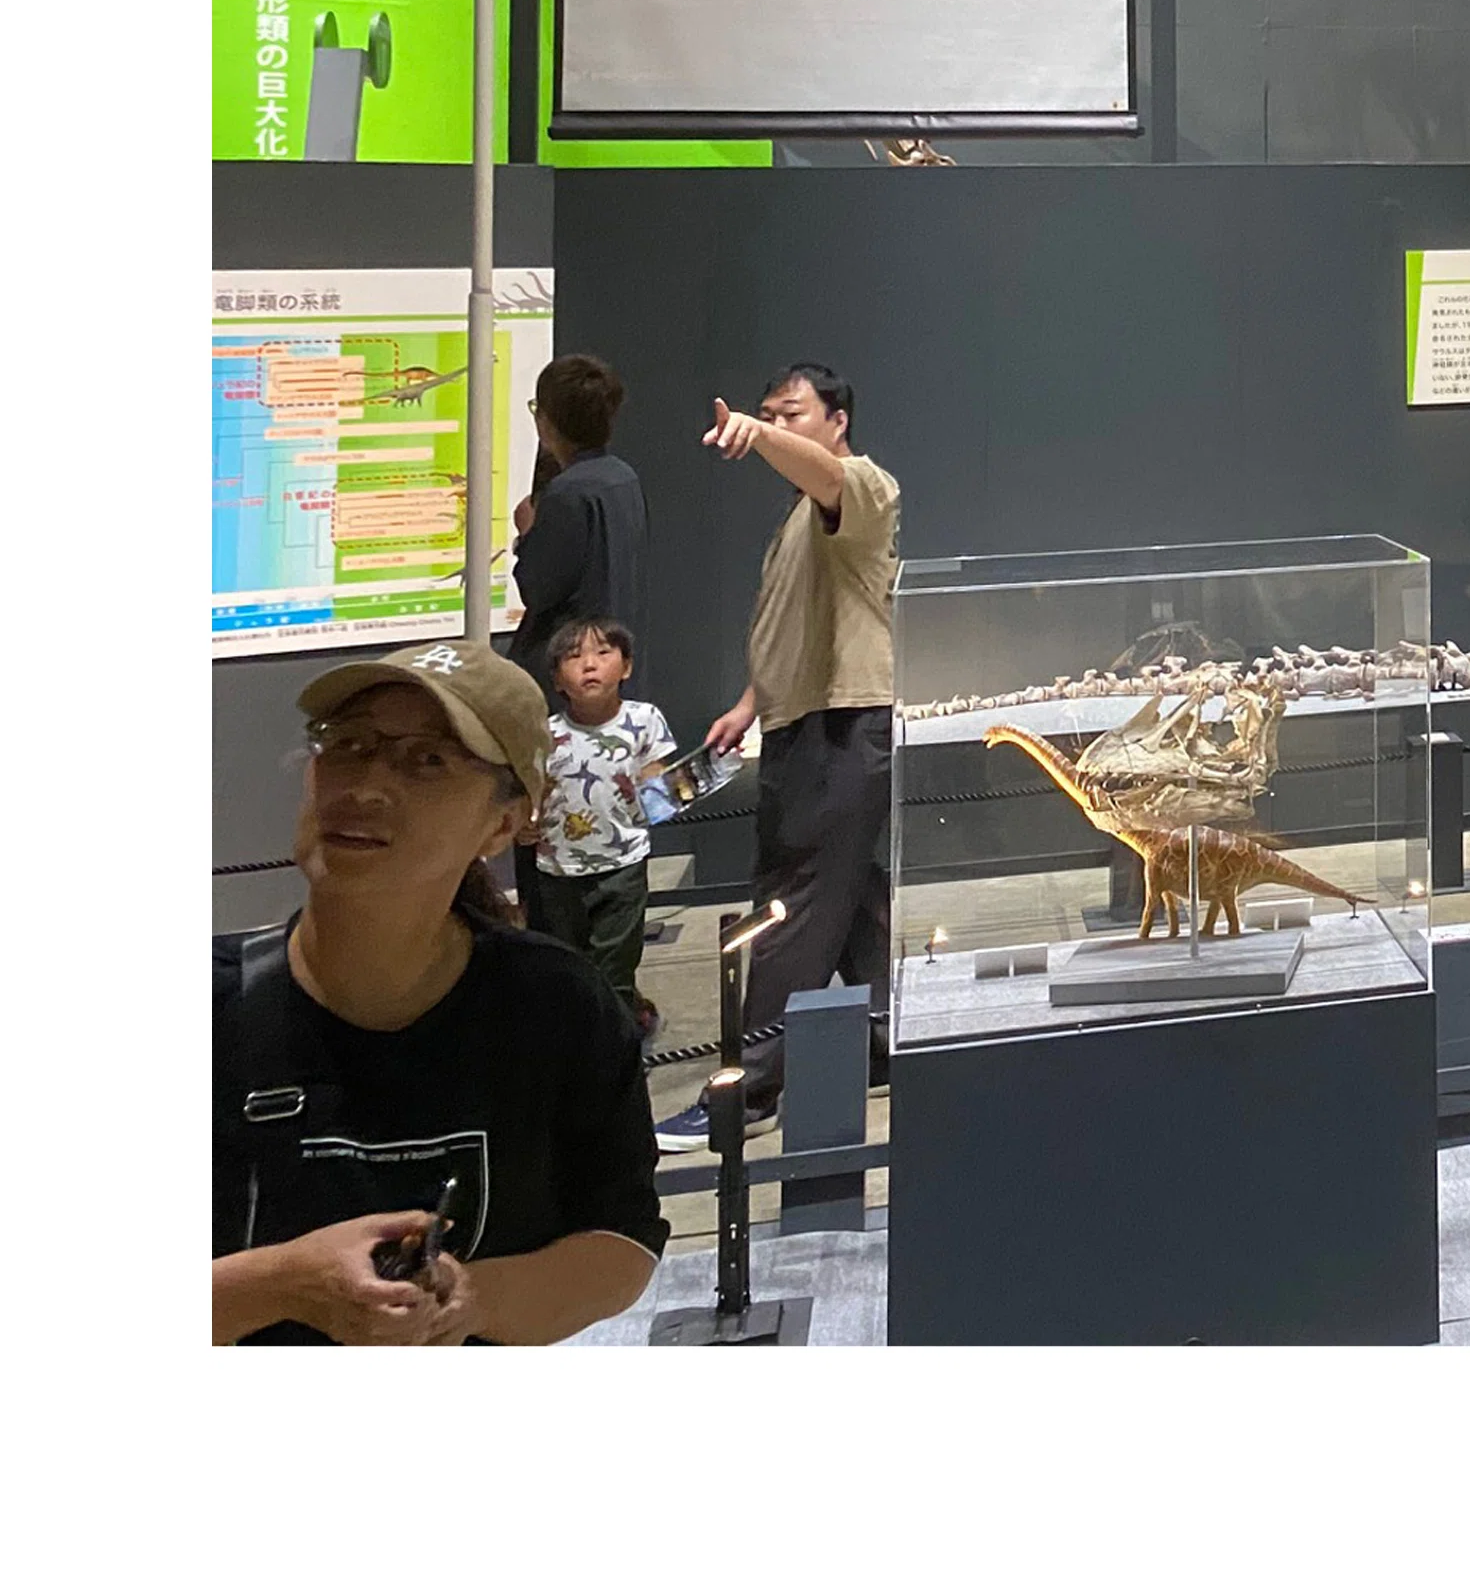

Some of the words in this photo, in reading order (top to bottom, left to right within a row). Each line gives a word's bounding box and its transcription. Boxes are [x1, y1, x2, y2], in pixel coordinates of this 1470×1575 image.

[214, 294, 342, 312] 竜脚類の系統
